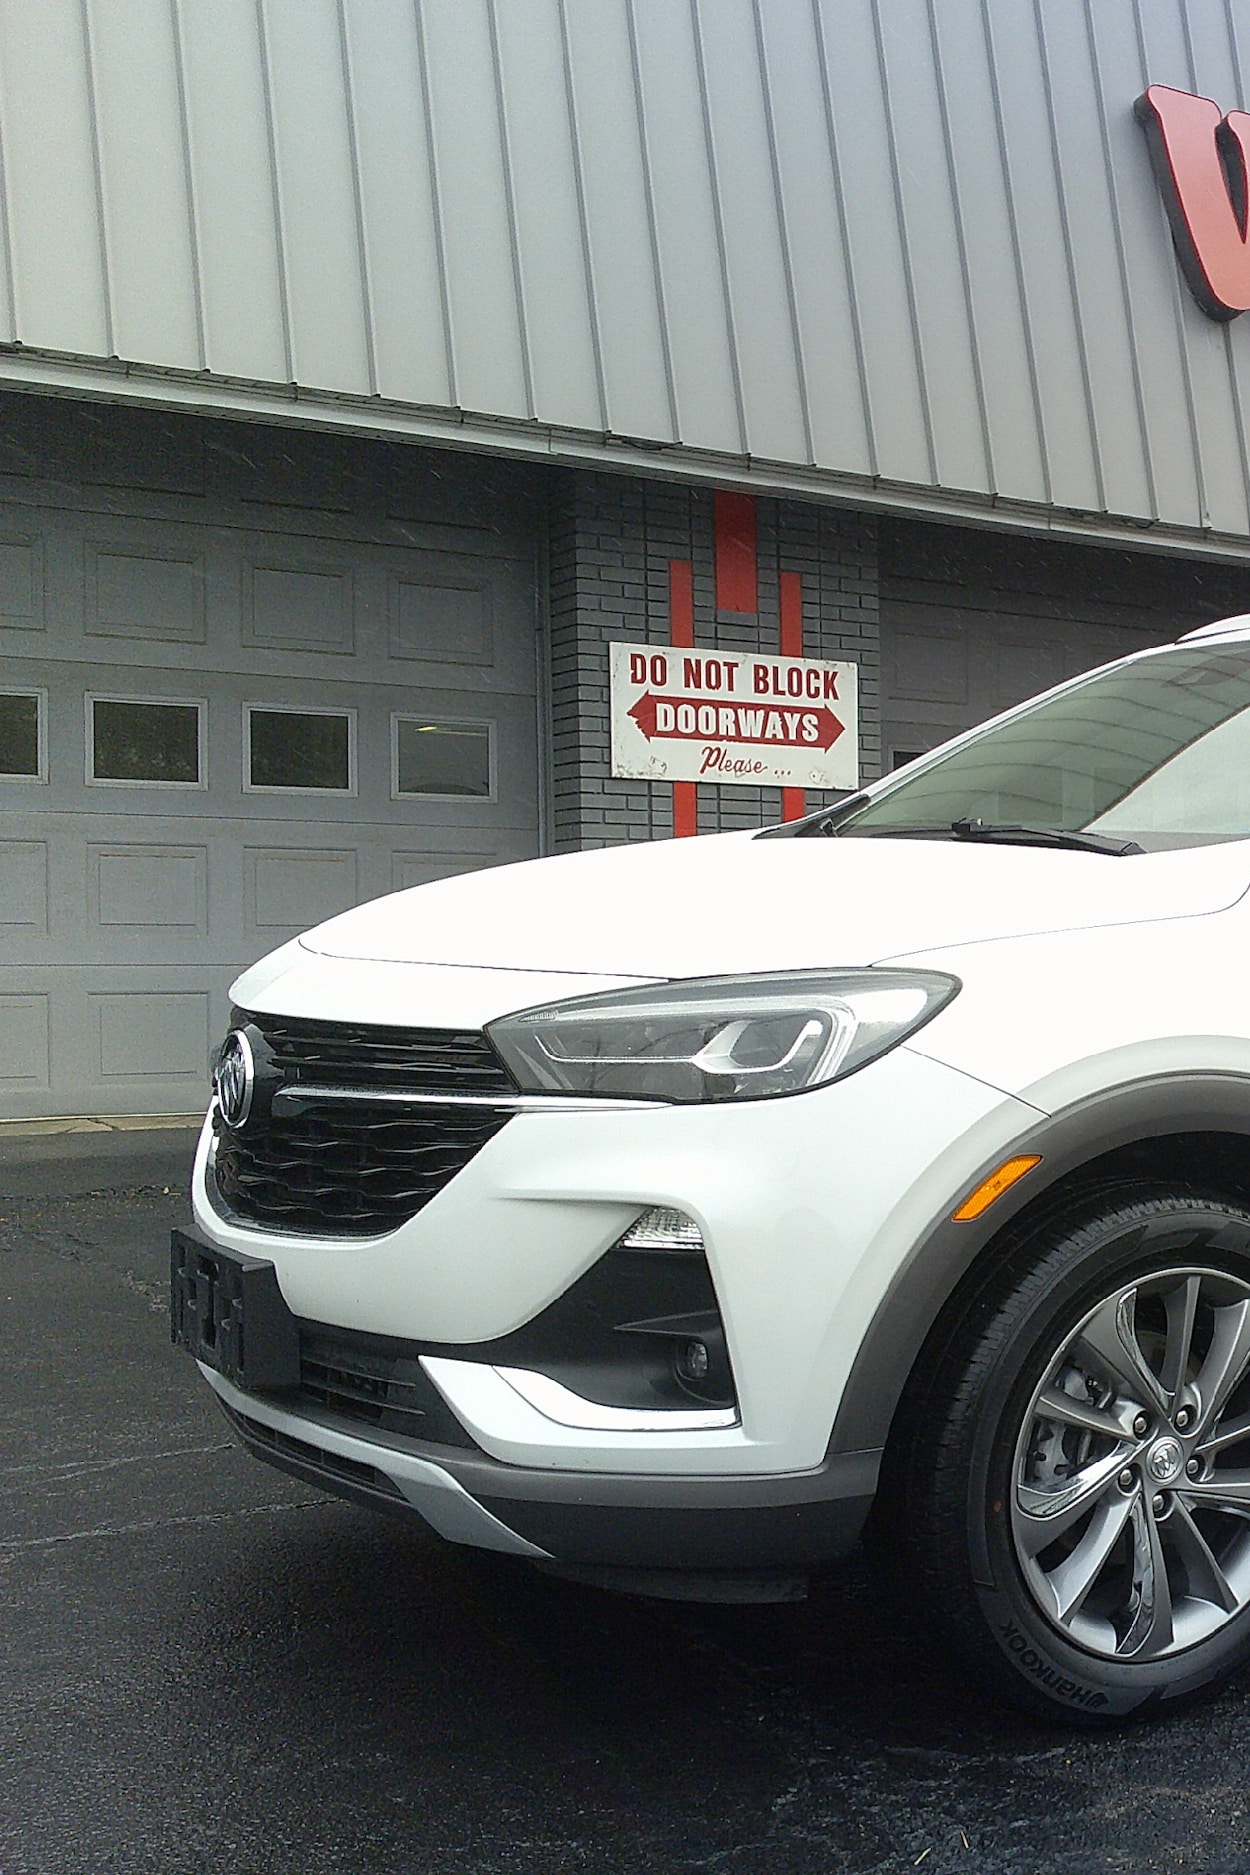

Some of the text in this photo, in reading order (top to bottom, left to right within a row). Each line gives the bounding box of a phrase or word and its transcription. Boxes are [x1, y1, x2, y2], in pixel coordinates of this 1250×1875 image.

[629, 652, 840, 701] DO NOT BLOCK
[654, 702, 820, 743] DOORWAYS
